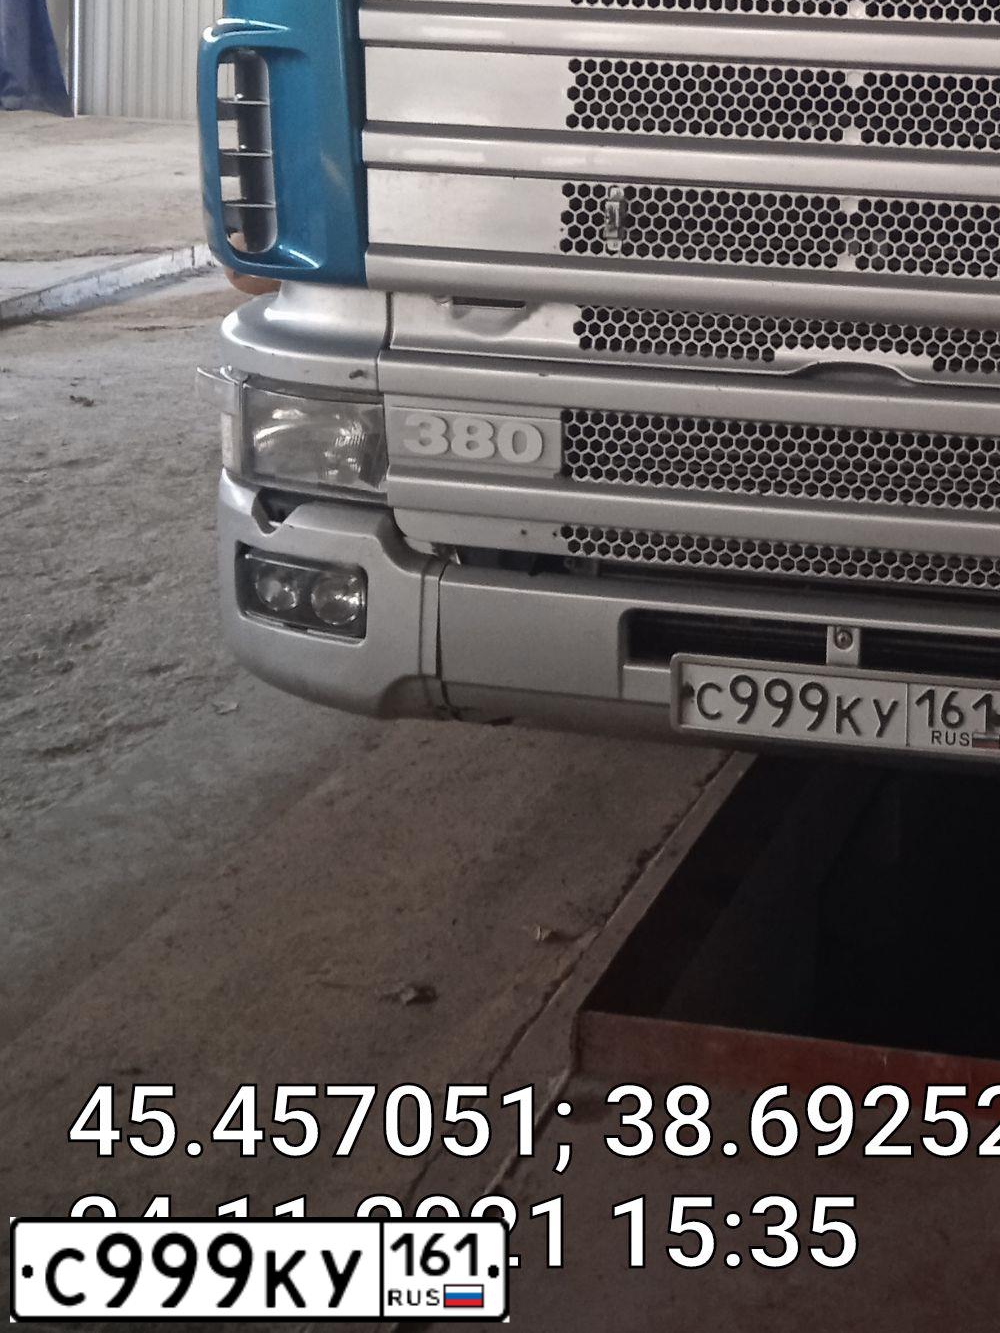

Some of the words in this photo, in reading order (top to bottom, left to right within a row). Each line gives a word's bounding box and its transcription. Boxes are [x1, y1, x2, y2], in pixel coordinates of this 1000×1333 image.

[402, 414, 543, 464] 380
[914, 688, 996, 732] 161
[931, 730, 971, 747] RUS
